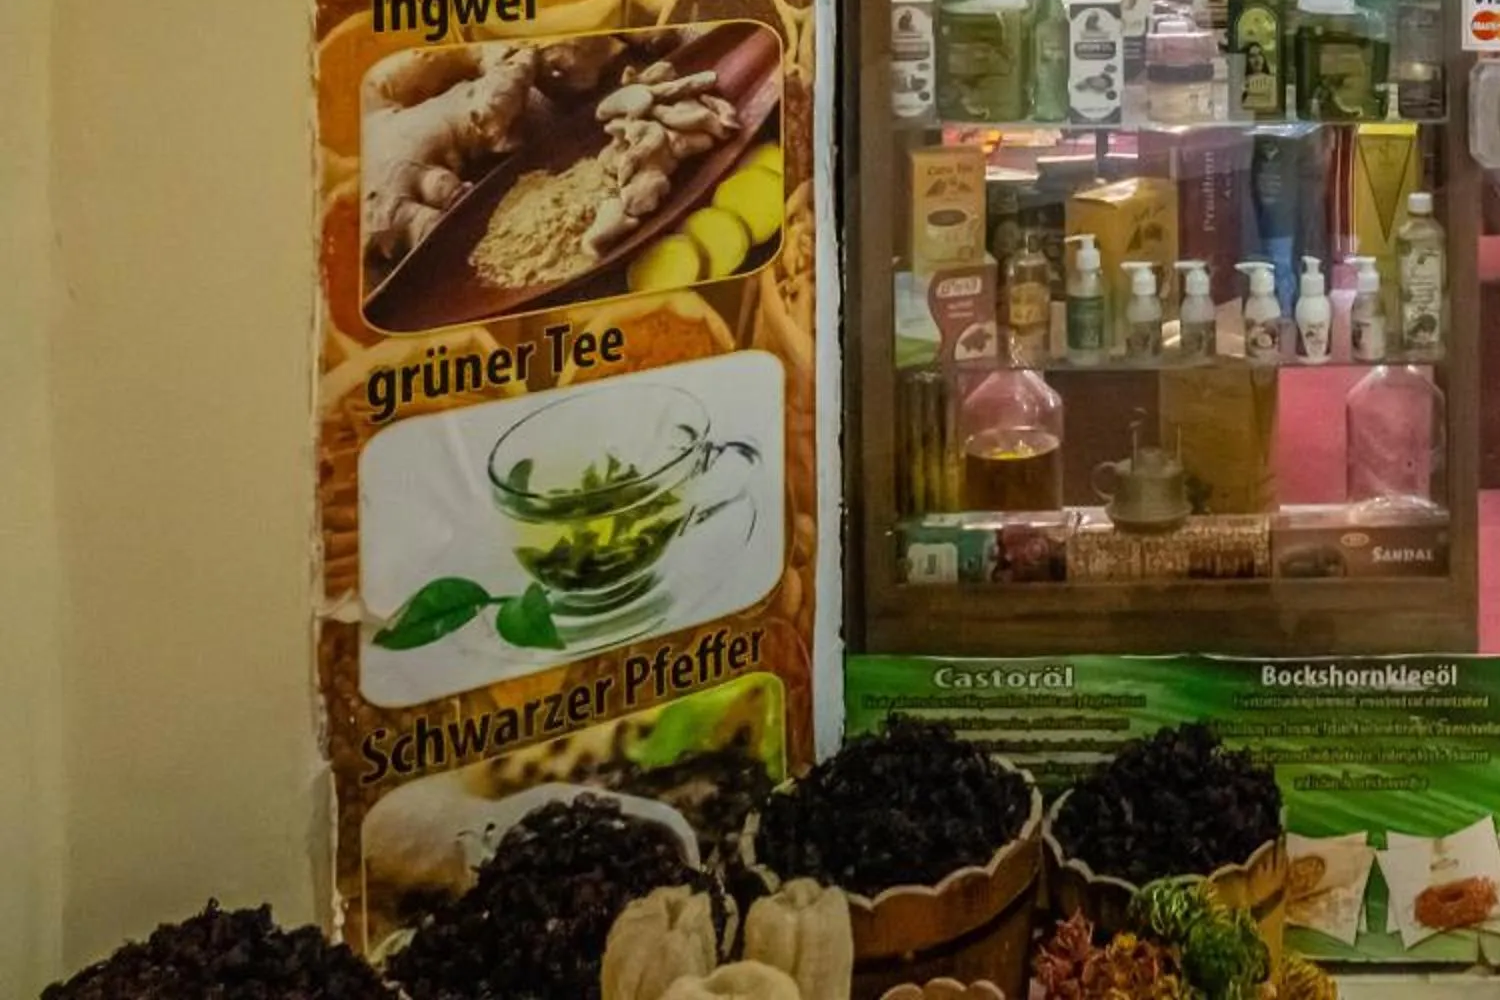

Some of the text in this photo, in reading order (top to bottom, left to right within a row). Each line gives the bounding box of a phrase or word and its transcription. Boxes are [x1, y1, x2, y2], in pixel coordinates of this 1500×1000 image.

[367, 324, 625, 423] grüner Tee
[360, 628, 766, 784] Schwarzer Pfeffer
[933, 666, 1075, 689] Castoröl
[1261, 664, 1457, 687] Bockshornkleeöl
